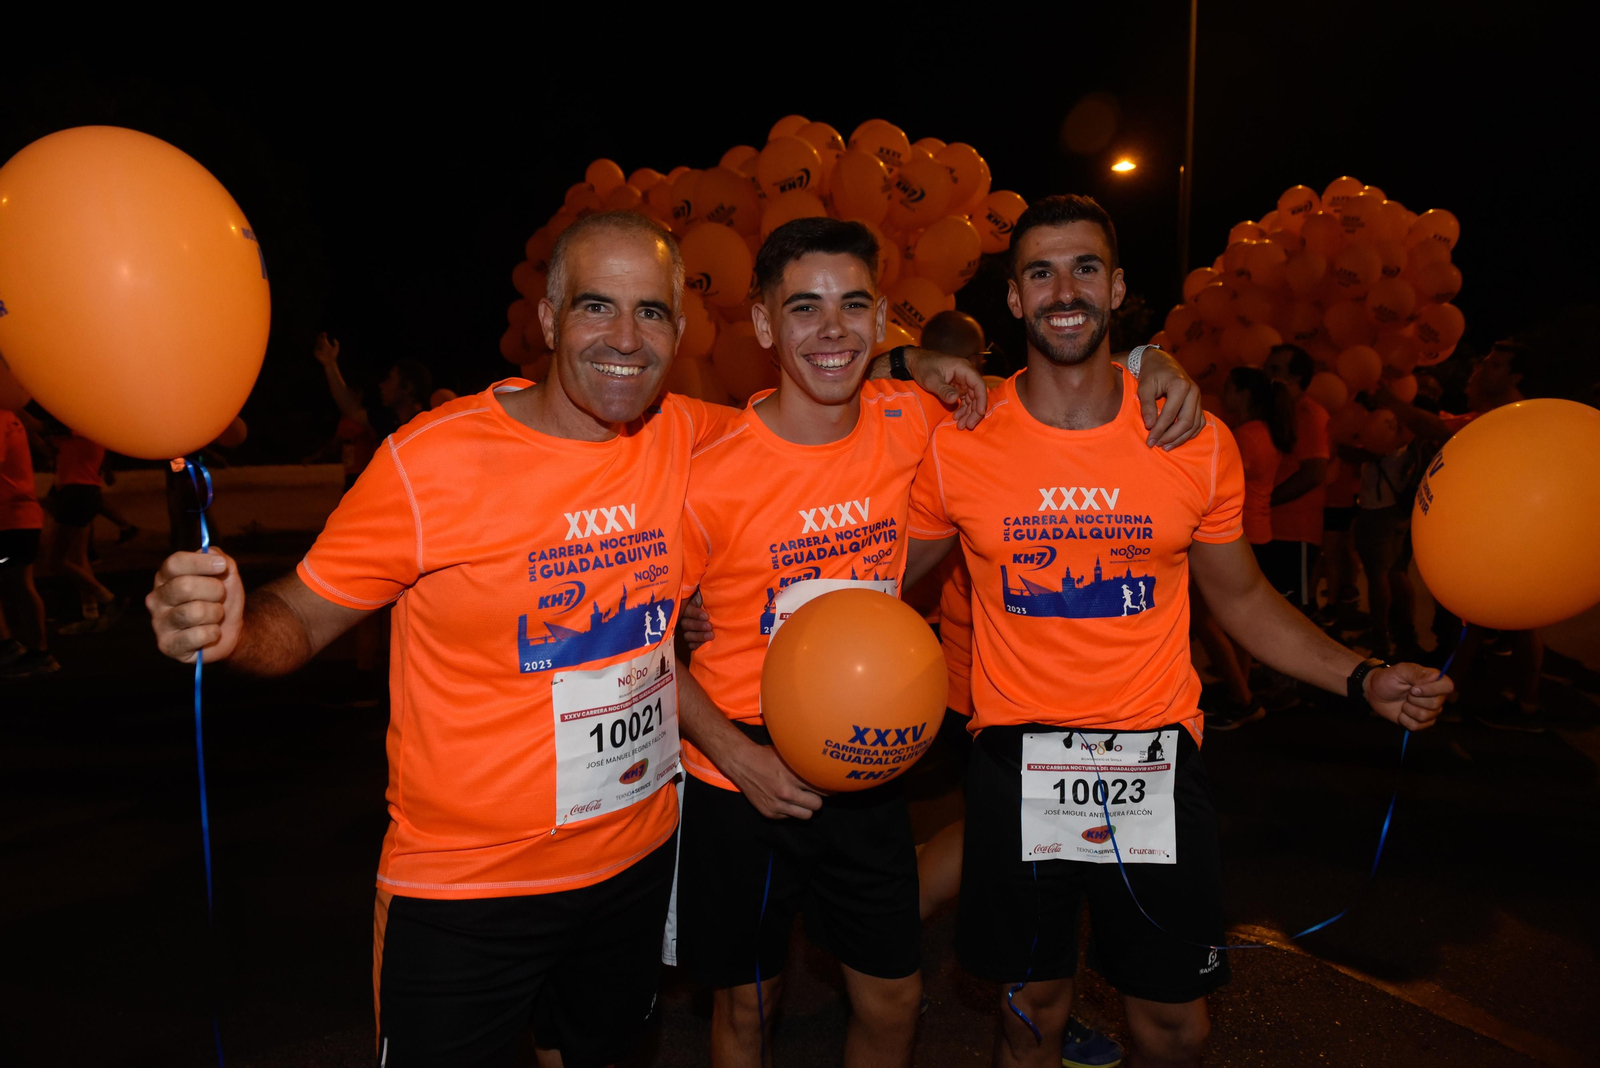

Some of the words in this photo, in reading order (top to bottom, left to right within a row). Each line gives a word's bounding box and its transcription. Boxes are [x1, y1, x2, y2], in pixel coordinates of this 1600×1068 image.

[1038, 487, 1120, 511] XXXV
[564, 503, 636, 540] XXXV
[798, 497, 870, 534] XXXV
[1003, 515, 1069, 526] CARRERA
[1075, 514, 1153, 525] NOCTURNA
[528, 543, 594, 563] CARRERA
[600, 528, 665, 551] NOCTURNA
[769, 534, 831, 554] CARRERA
[835, 517, 897, 542] NOCTURNA
[1013, 527, 1153, 541] GUADALQUIVIR
[528, 564, 537, 582] DEL
[540, 542, 668, 579] GUADALQUIVIR
[771, 555, 779, 570] DEL
[781, 529, 897, 566] GUADALQUIVIR
[1007, 605, 1027, 615] 2023
[524, 659, 552, 672] 2023
[563, 712, 581, 720] XXXV
[581, 706, 608, 717] CARRERA
[589, 697, 663, 752] 10021
[848, 722, 927, 747] XXXV
[586, 758, 604, 769] JOSÉ
[606, 752, 631, 765] MANUEL
[631, 742, 652, 756] BEGINES
[825, 739, 879, 757] CARRERA
[1053, 778, 1146, 806] 10023
[1126, 808, 1153, 816] FALCÓN
